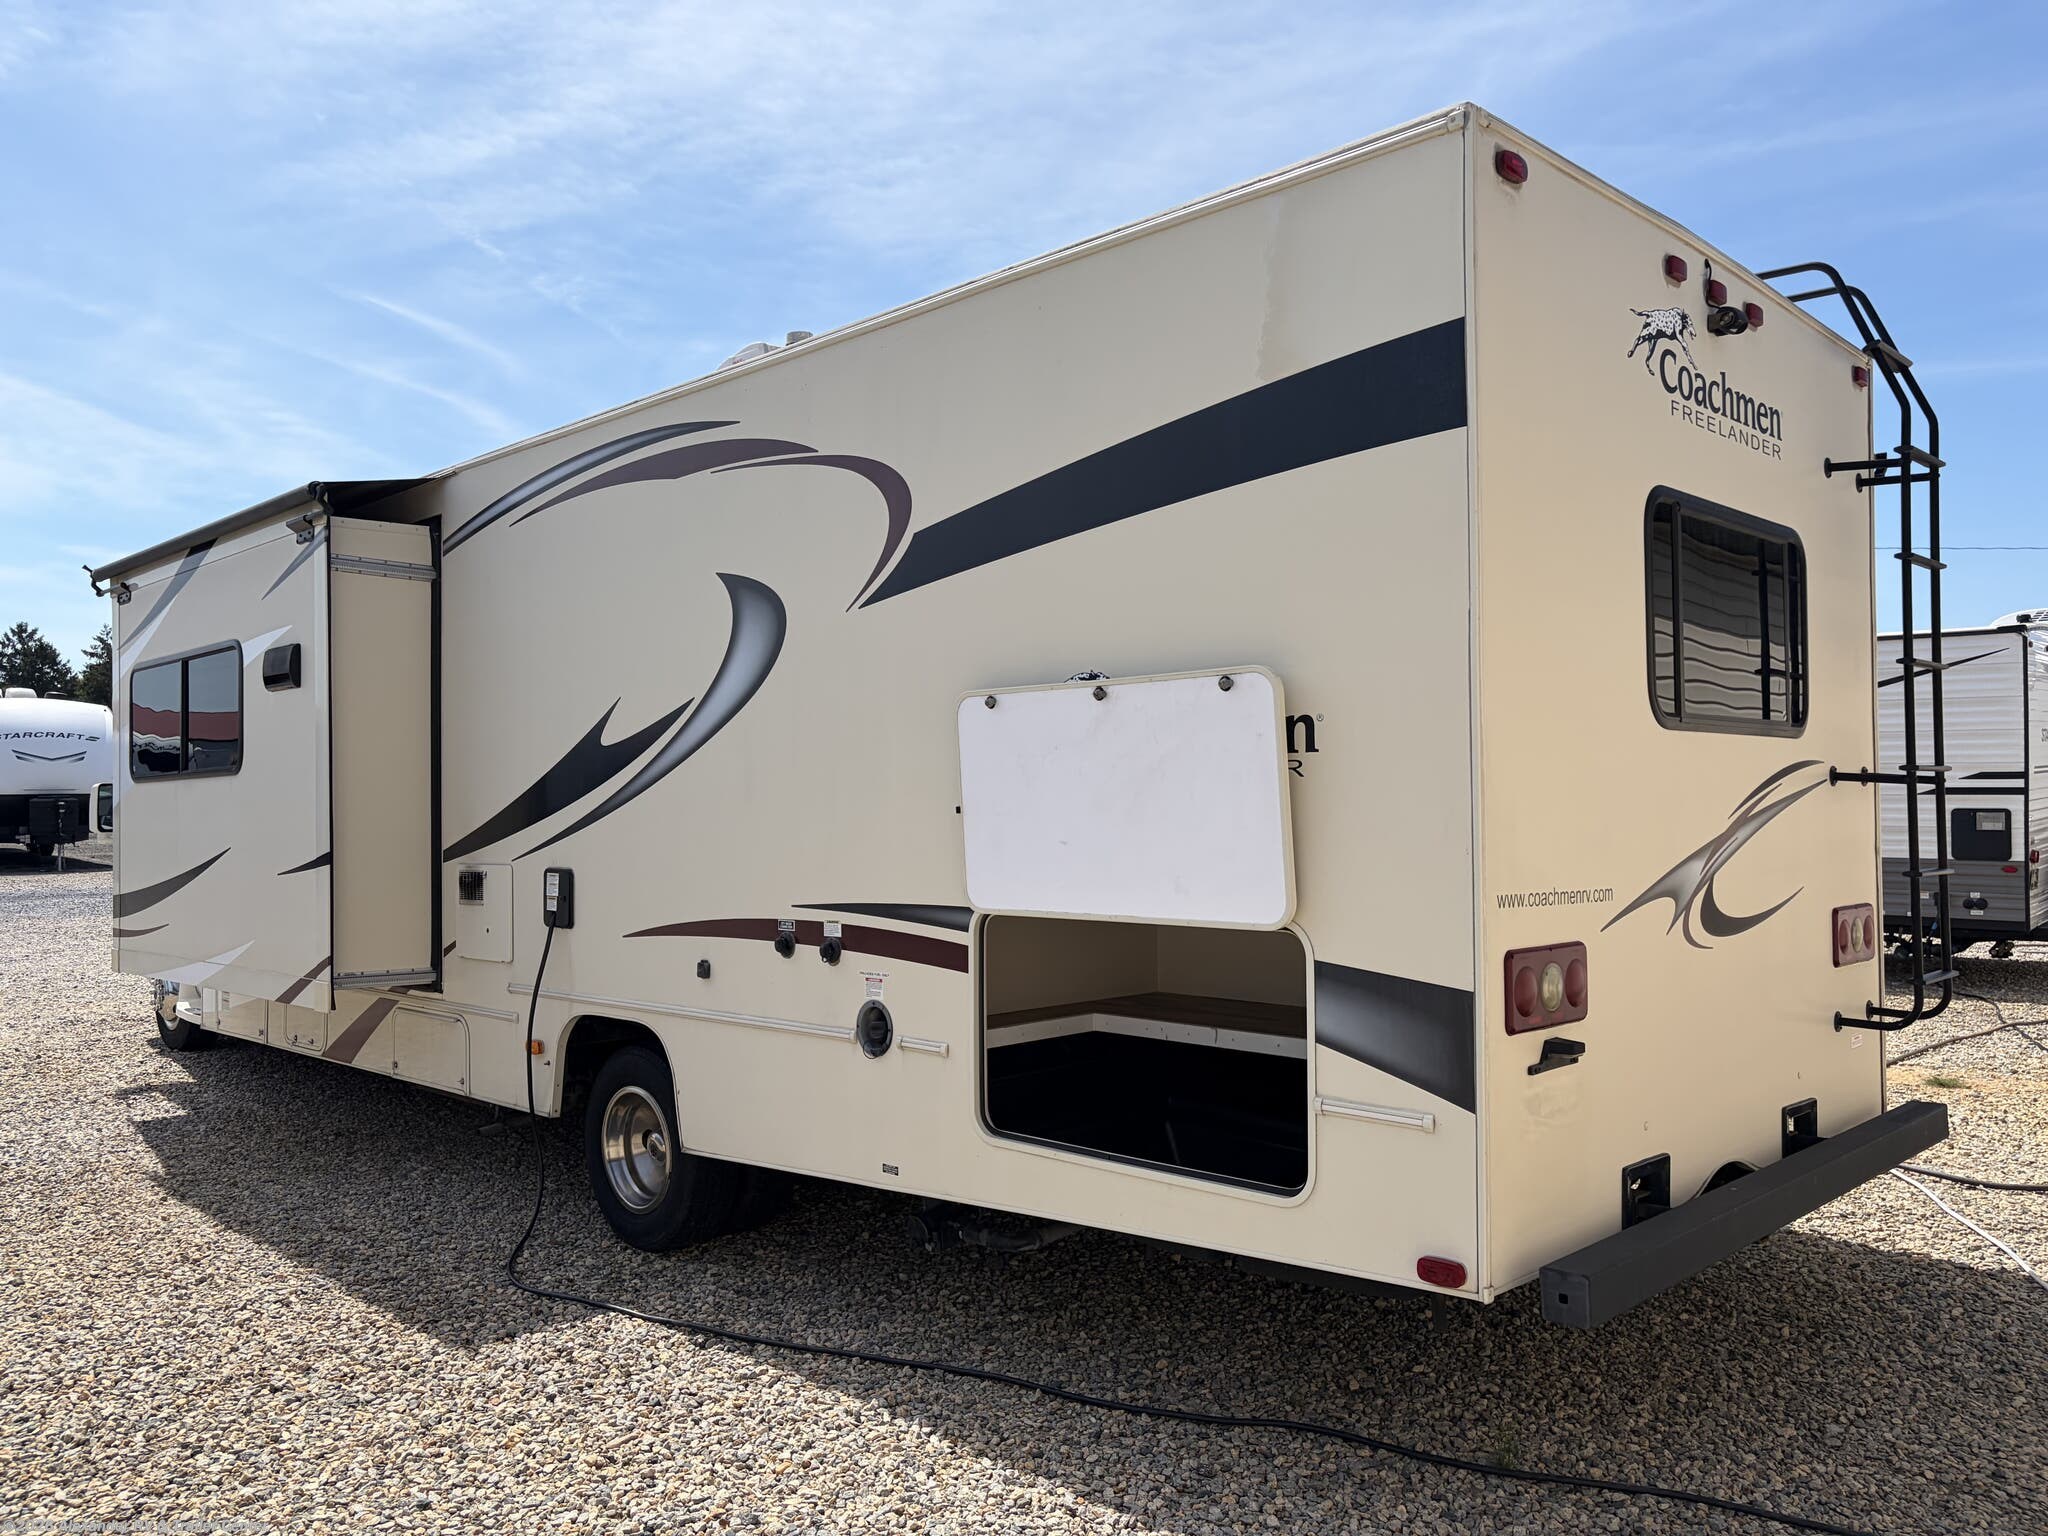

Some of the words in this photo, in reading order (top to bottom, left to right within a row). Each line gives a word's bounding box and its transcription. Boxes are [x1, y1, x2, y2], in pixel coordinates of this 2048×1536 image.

[1660, 349, 1783, 441] Coachmen
[1671, 400, 1782, 460] FREELANDER
[0, 731, 85, 740] TARCRAFT
[1497, 887, 1614, 909] www.coachmenrv.com
